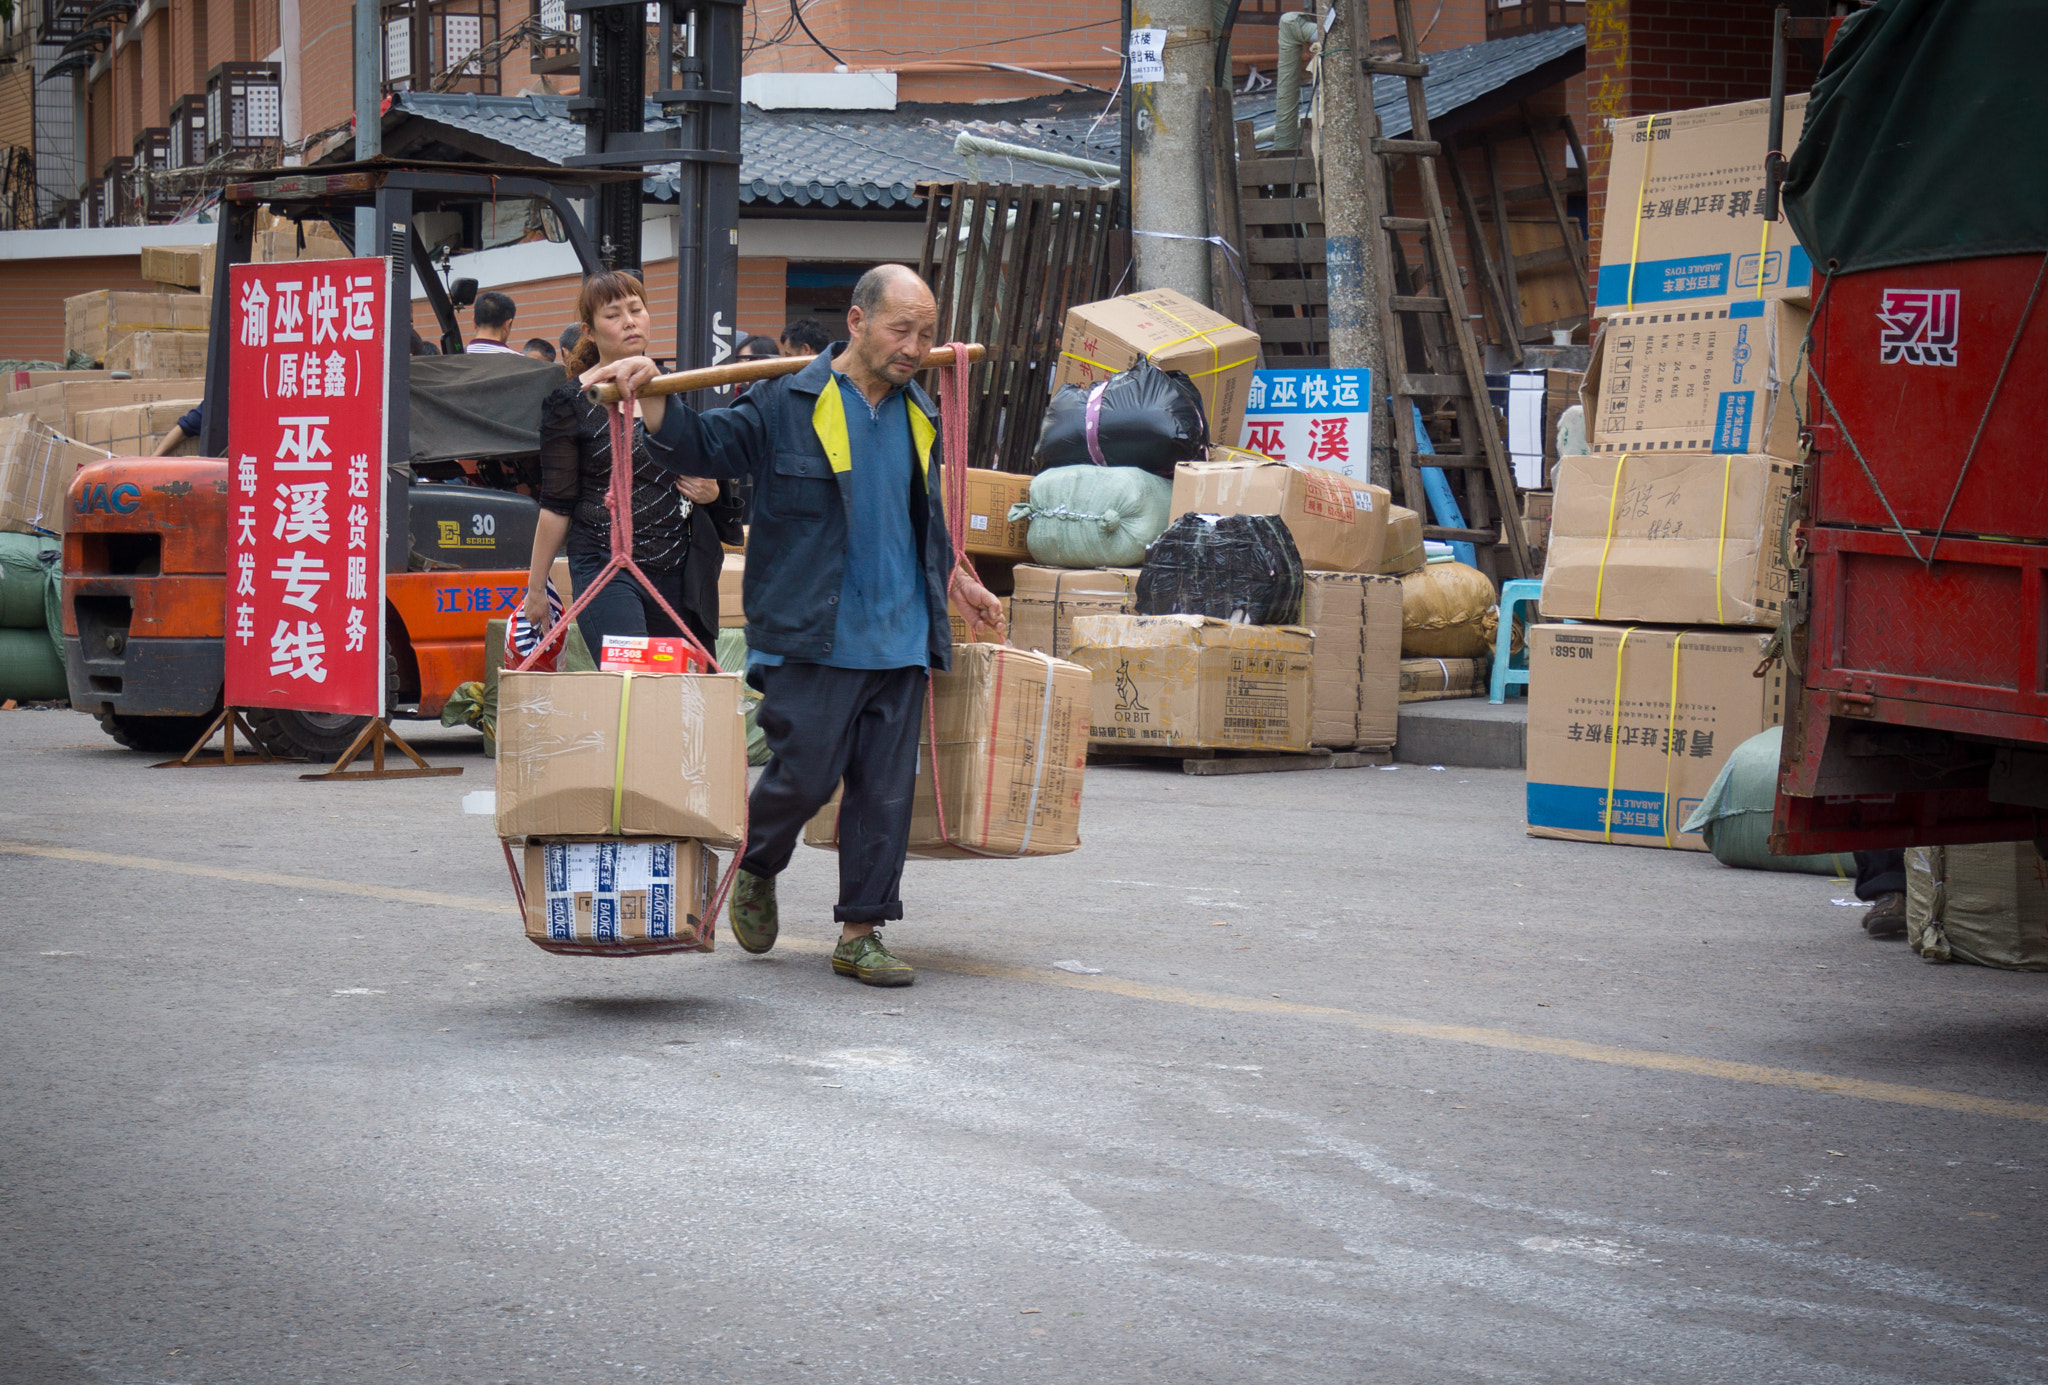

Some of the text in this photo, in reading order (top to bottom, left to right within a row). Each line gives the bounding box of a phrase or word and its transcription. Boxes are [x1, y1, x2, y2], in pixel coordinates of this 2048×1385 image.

[1664, 262, 1723, 276] JIABAILE TOYS
[1662, 274, 1721, 292] 嘉百乐童车
[240, 275, 375, 347] 渝巫快运
[1708, 331, 1716, 348] ITEM
[1875, 288, 1960, 367] 烈
[1654, 390, 1663, 403] KGS
[1671, 385, 1680, 398] KGS
[1686, 384, 1694, 397] PCS
[1722, 395, 1735, 448] BUBUBABY
[74, 483, 141, 515] JAC
[437, 521, 461, 548] E
[472, 514, 496, 536] 30
[235, 454, 258, 646] 每天发车
[269, 416, 333, 684] 巫溪专线
[345, 453, 370, 652] 送货服务
[607, 648, 642, 659] BT-508
[1114, 712, 1150, 723] ORBIT
[1623, 798, 1661, 809] JIABAILE
[601, 842, 612, 870] AOKE
[554, 902, 565, 935] BAOKE
[600, 903, 610, 935] BAOKE
[654, 887, 664, 936] BAOKE 宝克
